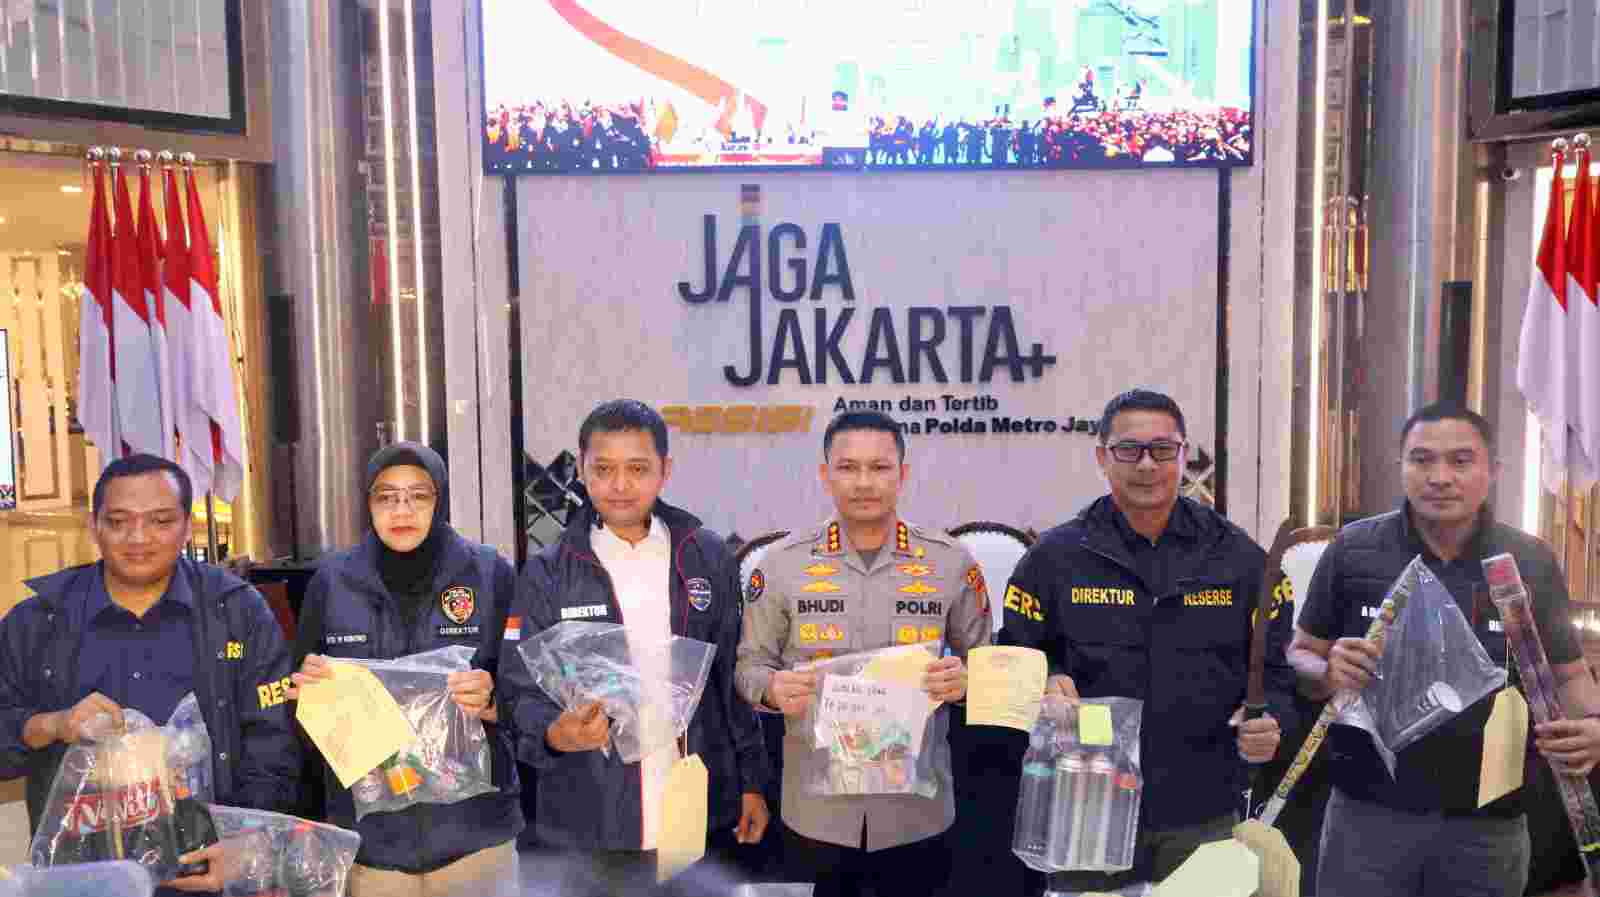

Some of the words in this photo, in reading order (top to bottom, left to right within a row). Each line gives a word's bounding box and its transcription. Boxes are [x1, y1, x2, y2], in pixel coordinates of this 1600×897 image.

[677, 211, 856, 304] JAGA
[899, 395, 937, 412] dan
[941, 394, 999, 411] Tertib
[925, 417, 987, 433] Polda
[992, 416, 1056, 433] Metro
[1061, 416, 1100, 436] Jay
[1071, 587, 1136, 605] DIREKTUR
[797, 599, 845, 614] BHUDI
[895, 601, 942, 616] POLRI
